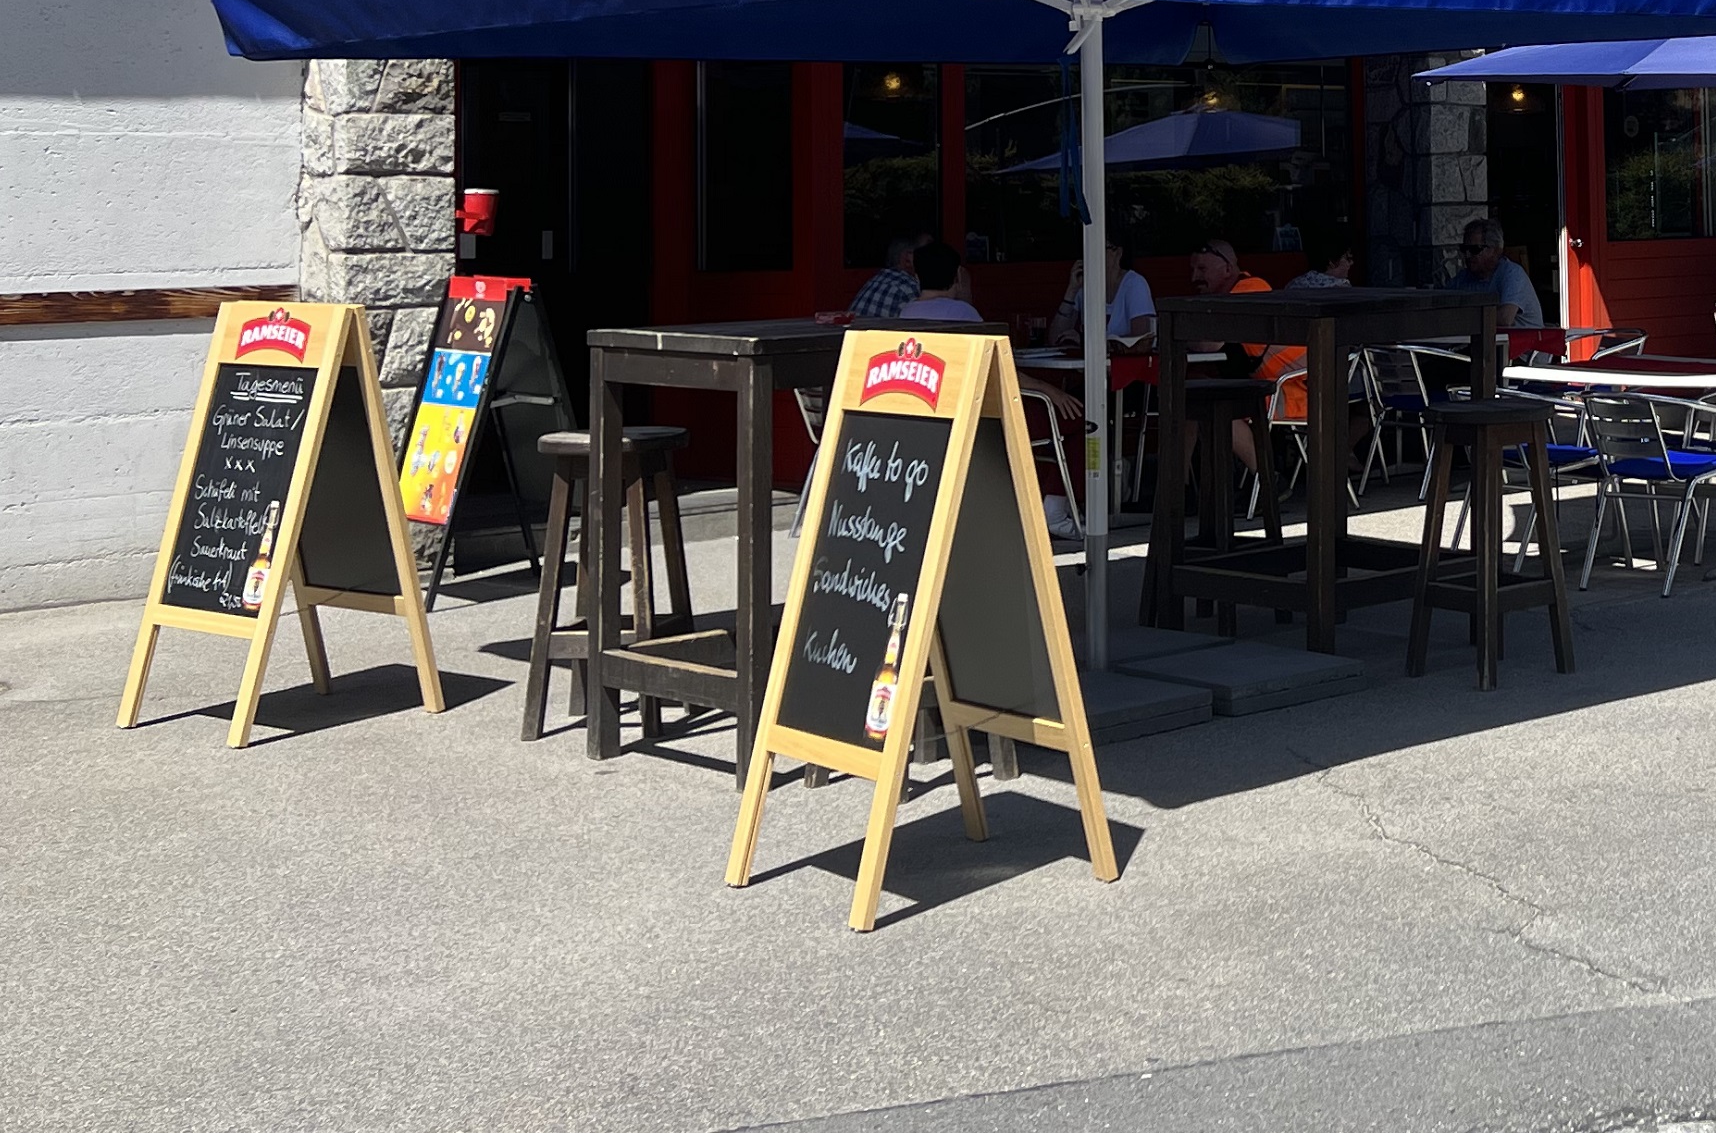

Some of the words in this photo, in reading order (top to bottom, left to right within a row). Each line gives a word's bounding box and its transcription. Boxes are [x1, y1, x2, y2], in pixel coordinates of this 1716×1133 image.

[240, 323, 306, 349] RAMSEIER
[235, 372, 304, 400] Tagesmenü
[866, 360, 940, 393] RAMSEIER
[212, 404, 252, 436] Grüner
[253, 405, 291, 428] Salat
[220, 432, 285, 461] Linsensuppe
[840, 437, 882, 493] Kaffee
[884, 440, 903, 482] to
[904, 459, 929, 503] go
[240, 480, 261, 503] mit
[190, 535, 248, 561] Sauerkraut
[812, 556, 891, 613] Sandwiches
[802, 626, 858, 675] Kuchen
